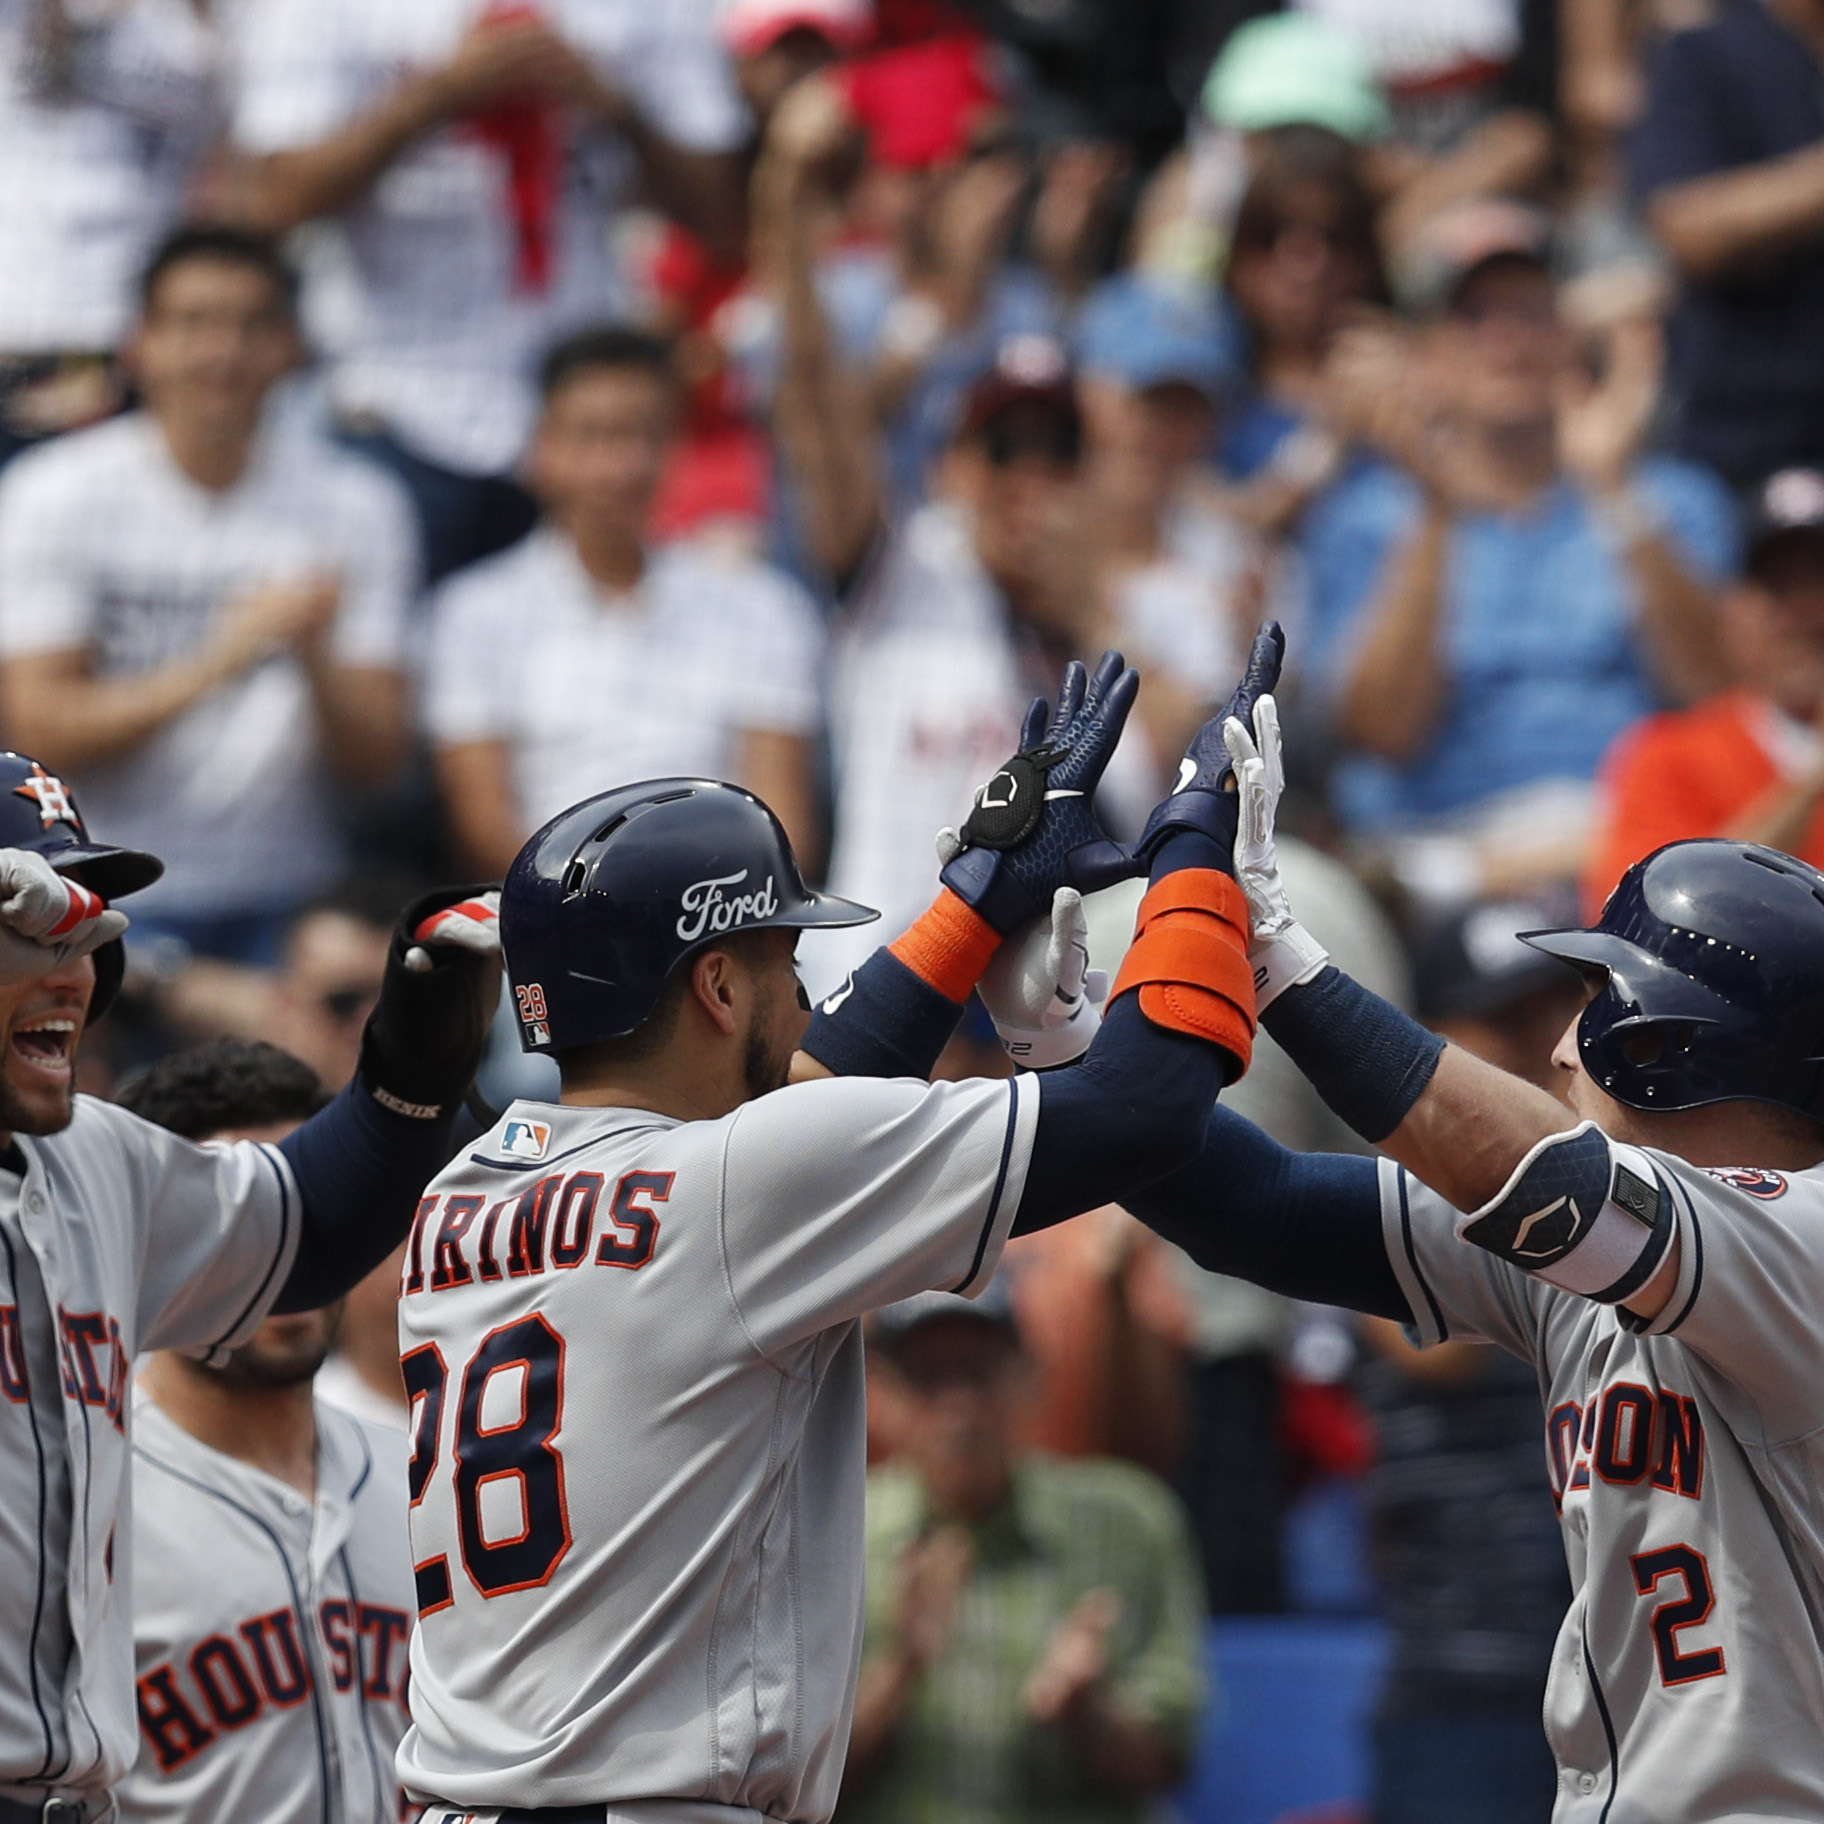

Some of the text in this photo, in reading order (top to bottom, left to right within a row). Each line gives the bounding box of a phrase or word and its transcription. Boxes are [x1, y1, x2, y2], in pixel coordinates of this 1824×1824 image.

[677, 868, 777, 941] Ford
[515, 983, 547, 1022] 28
[396, 1170, 676, 1299] IRINOS
[398, 1311, 573, 1620] 28
[1629, 1542, 1727, 1687] 2
[136, 1598, 412, 1774] HOUST
